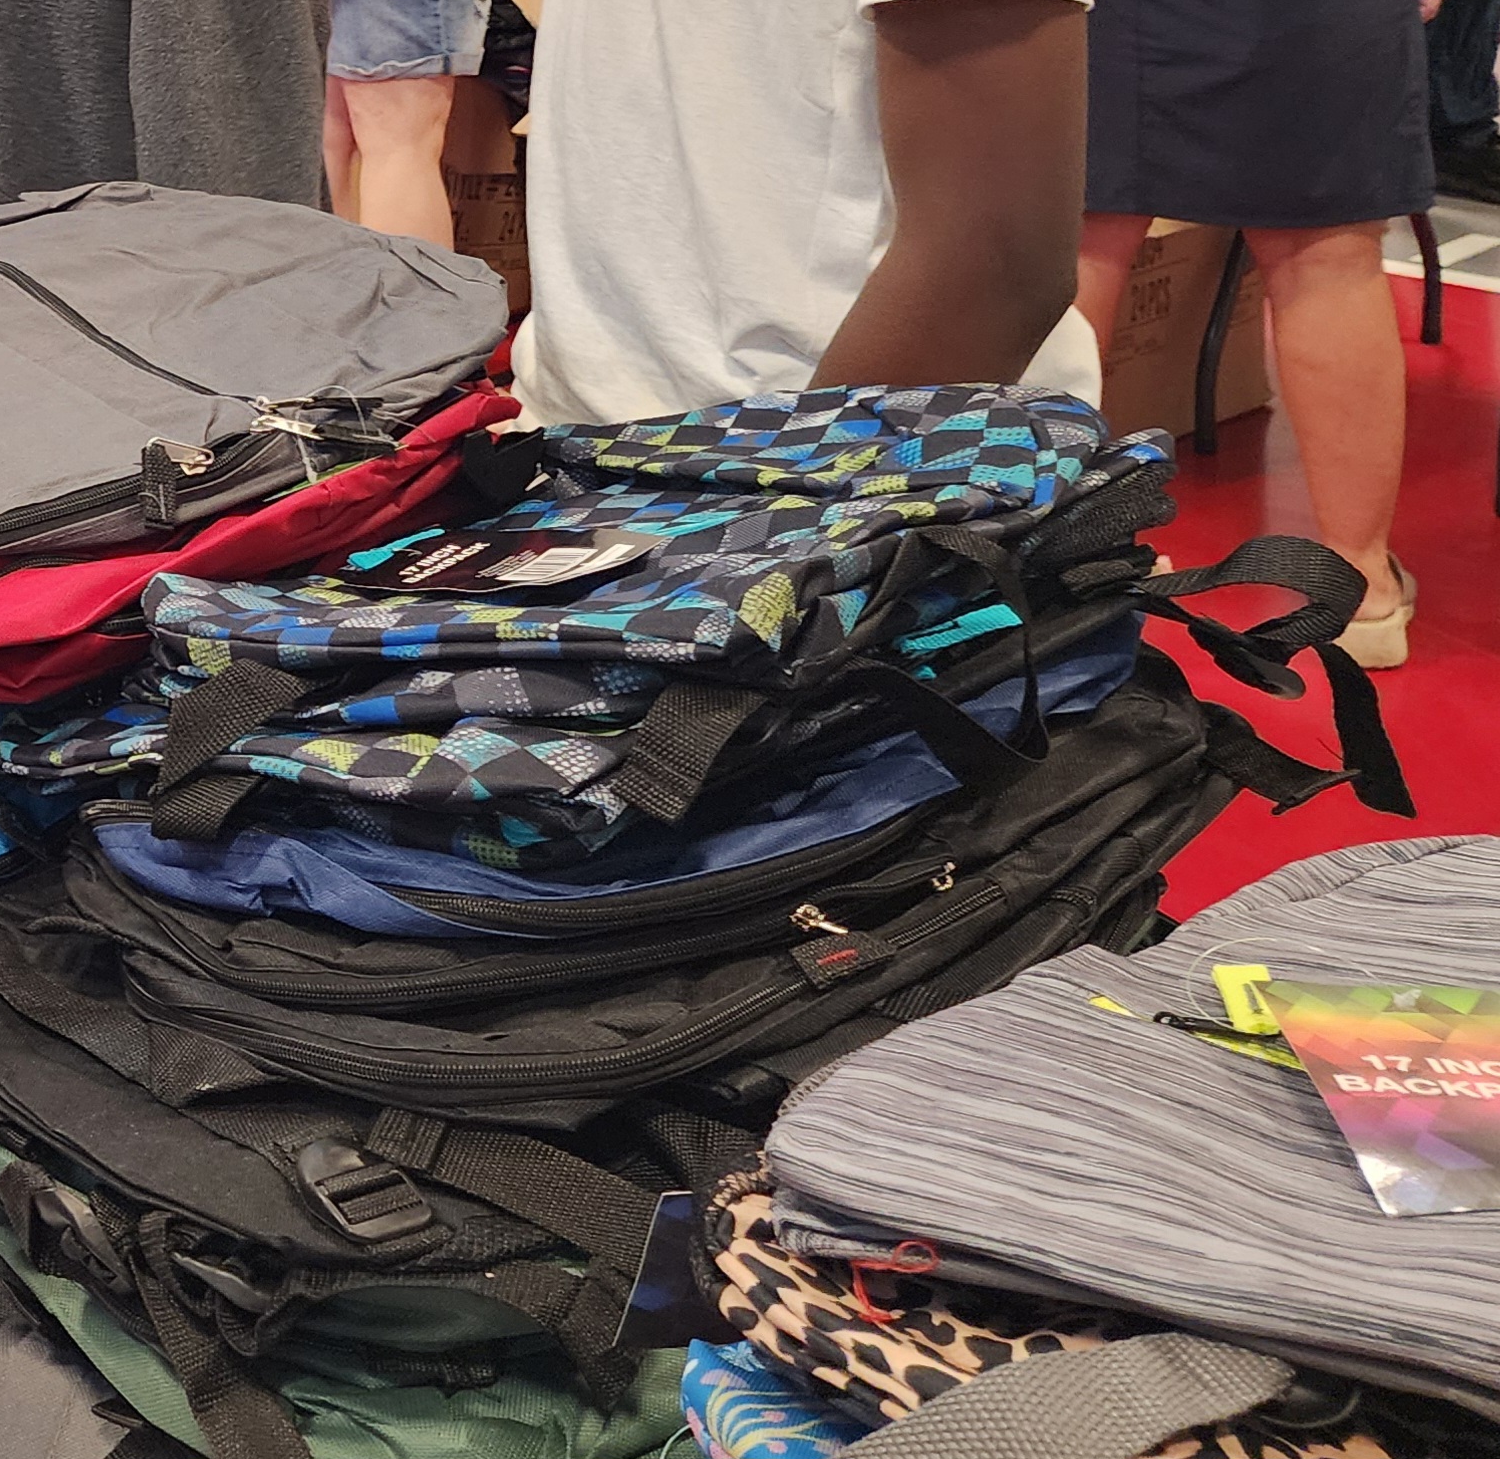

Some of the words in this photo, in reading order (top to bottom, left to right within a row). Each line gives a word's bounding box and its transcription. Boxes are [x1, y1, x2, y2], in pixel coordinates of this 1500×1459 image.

[399, 565, 421, 576] 17
[415, 544, 462, 567] INCH
[401, 542, 491, 584] BACKPACK
[1362, 1053, 1414, 1072] 17
